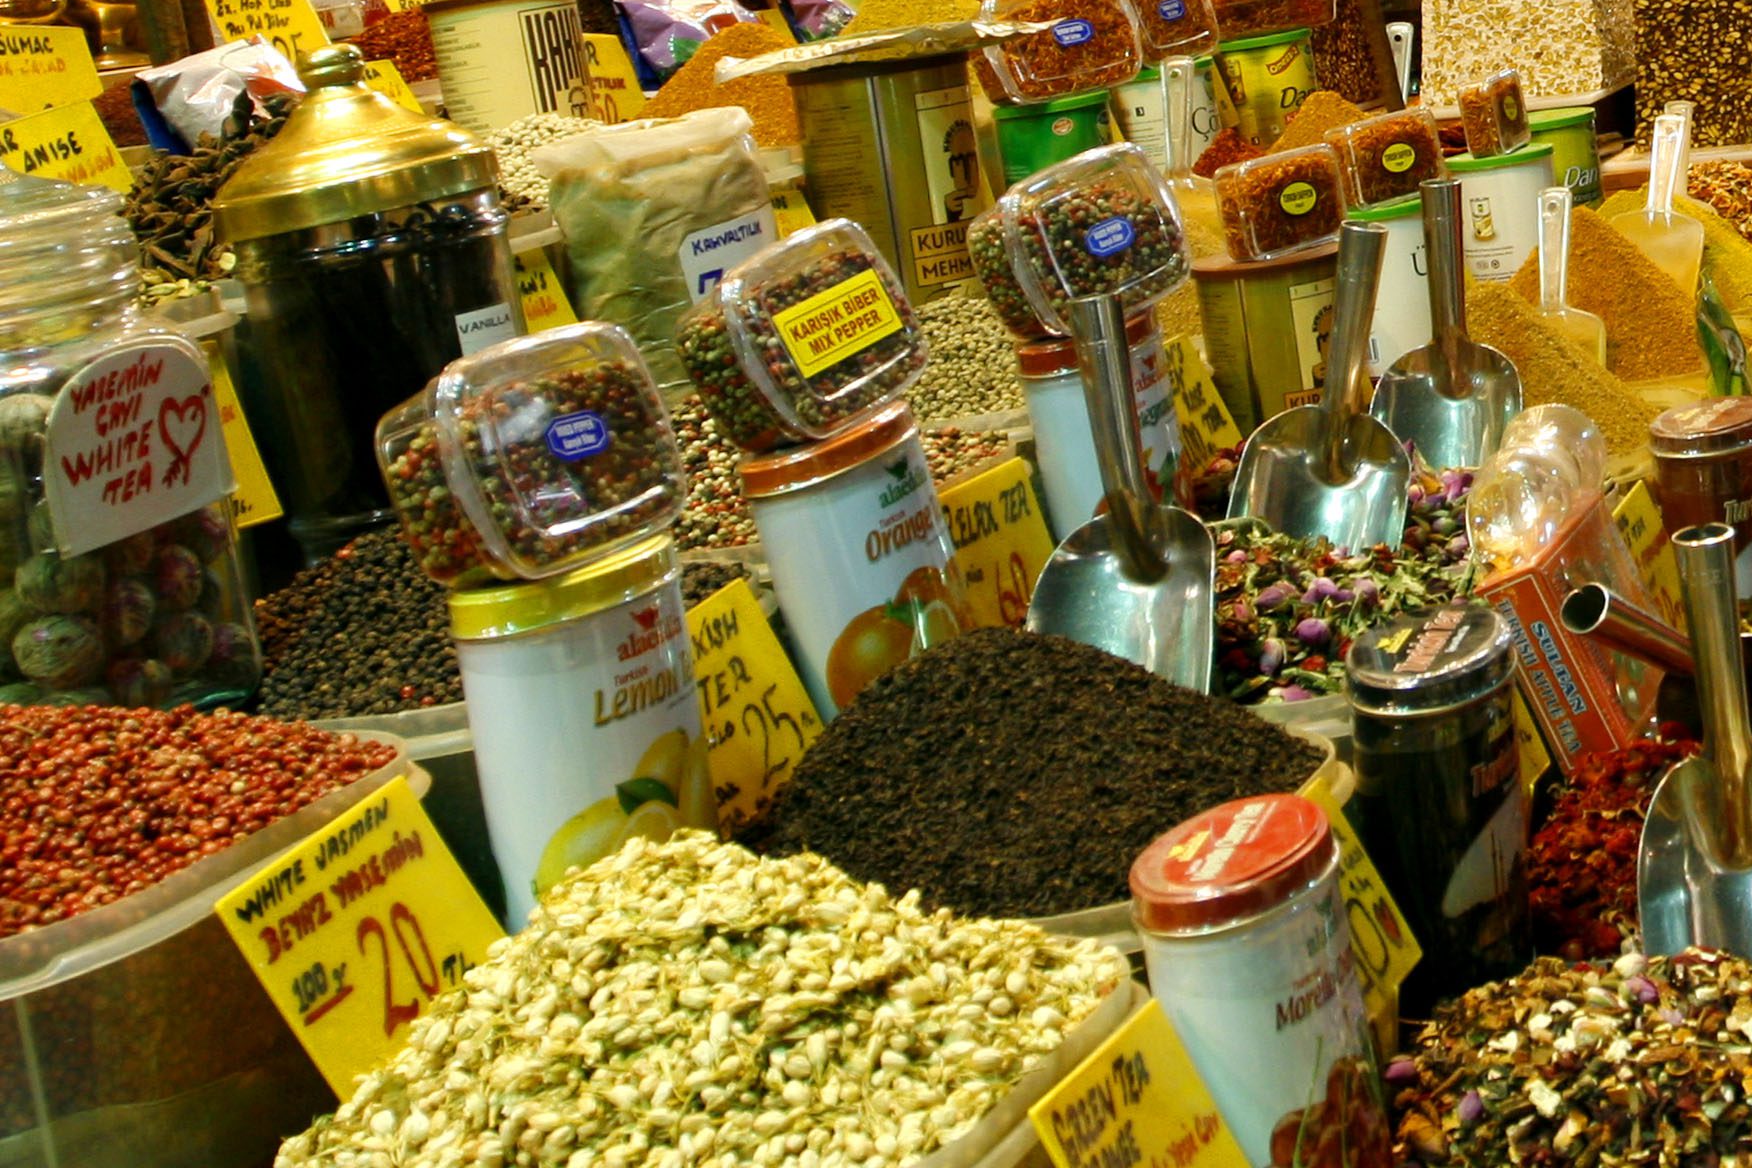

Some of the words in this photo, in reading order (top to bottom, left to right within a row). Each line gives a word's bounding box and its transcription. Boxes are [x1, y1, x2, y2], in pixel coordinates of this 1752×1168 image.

[24, 132, 82, 174] ANISE
[917, 228, 968, 252] KURU
[922, 256, 973, 280] MEHM
[789, 307, 844, 344] KARIŞIK
[808, 333, 836, 357] MIX
[835, 309, 883, 343] PEPPER
[61, 420, 155, 487] WHITE
[102, 461, 155, 507] TEA
[998, 479, 1032, 524] TEA
[865, 506, 934, 563] Orange
[593, 668, 679, 728] Lemon
[699, 656, 752, 716] TEA
[1533, 667, 1565, 720] APPLE
[1558, 717, 1582, 753] TEA
[742, 683, 804, 789] 25
[235, 859, 307, 924] WHITE
[314, 798, 389, 872] JASMEN
[356, 901, 441, 1040] 20
[1051, 1077, 1117, 1167] GREEN
[1111, 1050, 1151, 1107] TEA
